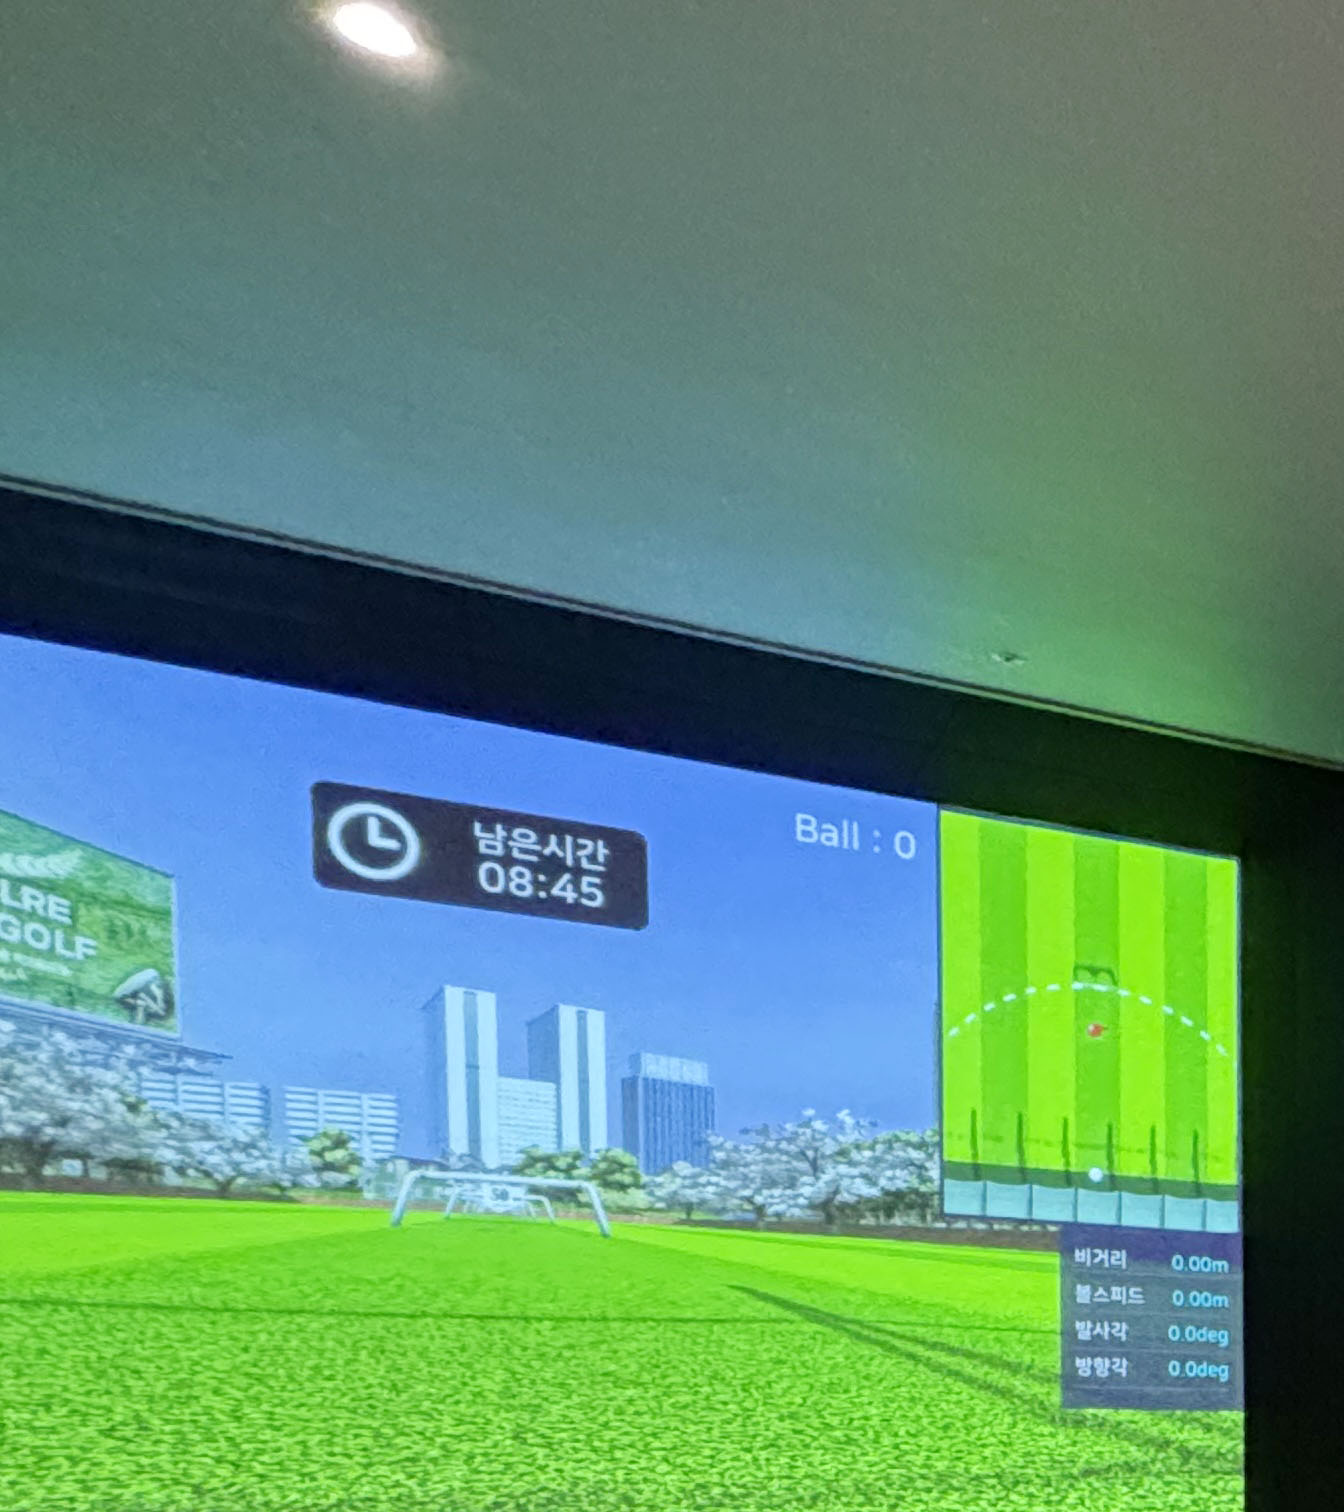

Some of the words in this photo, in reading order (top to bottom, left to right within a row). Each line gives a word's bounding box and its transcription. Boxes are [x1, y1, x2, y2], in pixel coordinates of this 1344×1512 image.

[473, 820, 610, 872] 남은시간
[795, 812, 860, 851] Ball
[478, 860, 605, 908] 08:45
[0, 911, 98, 961] GOLF
[1074, 1248, 1127, 1269] 비거리
[1171, 1254, 1230, 1273] 0.00m
[1172, 1289, 1230, 1308] 0.00m
[1168, 1325, 1230, 1347] 0.0deg
[1168, 1360, 1230, 1382] 0.0deg
